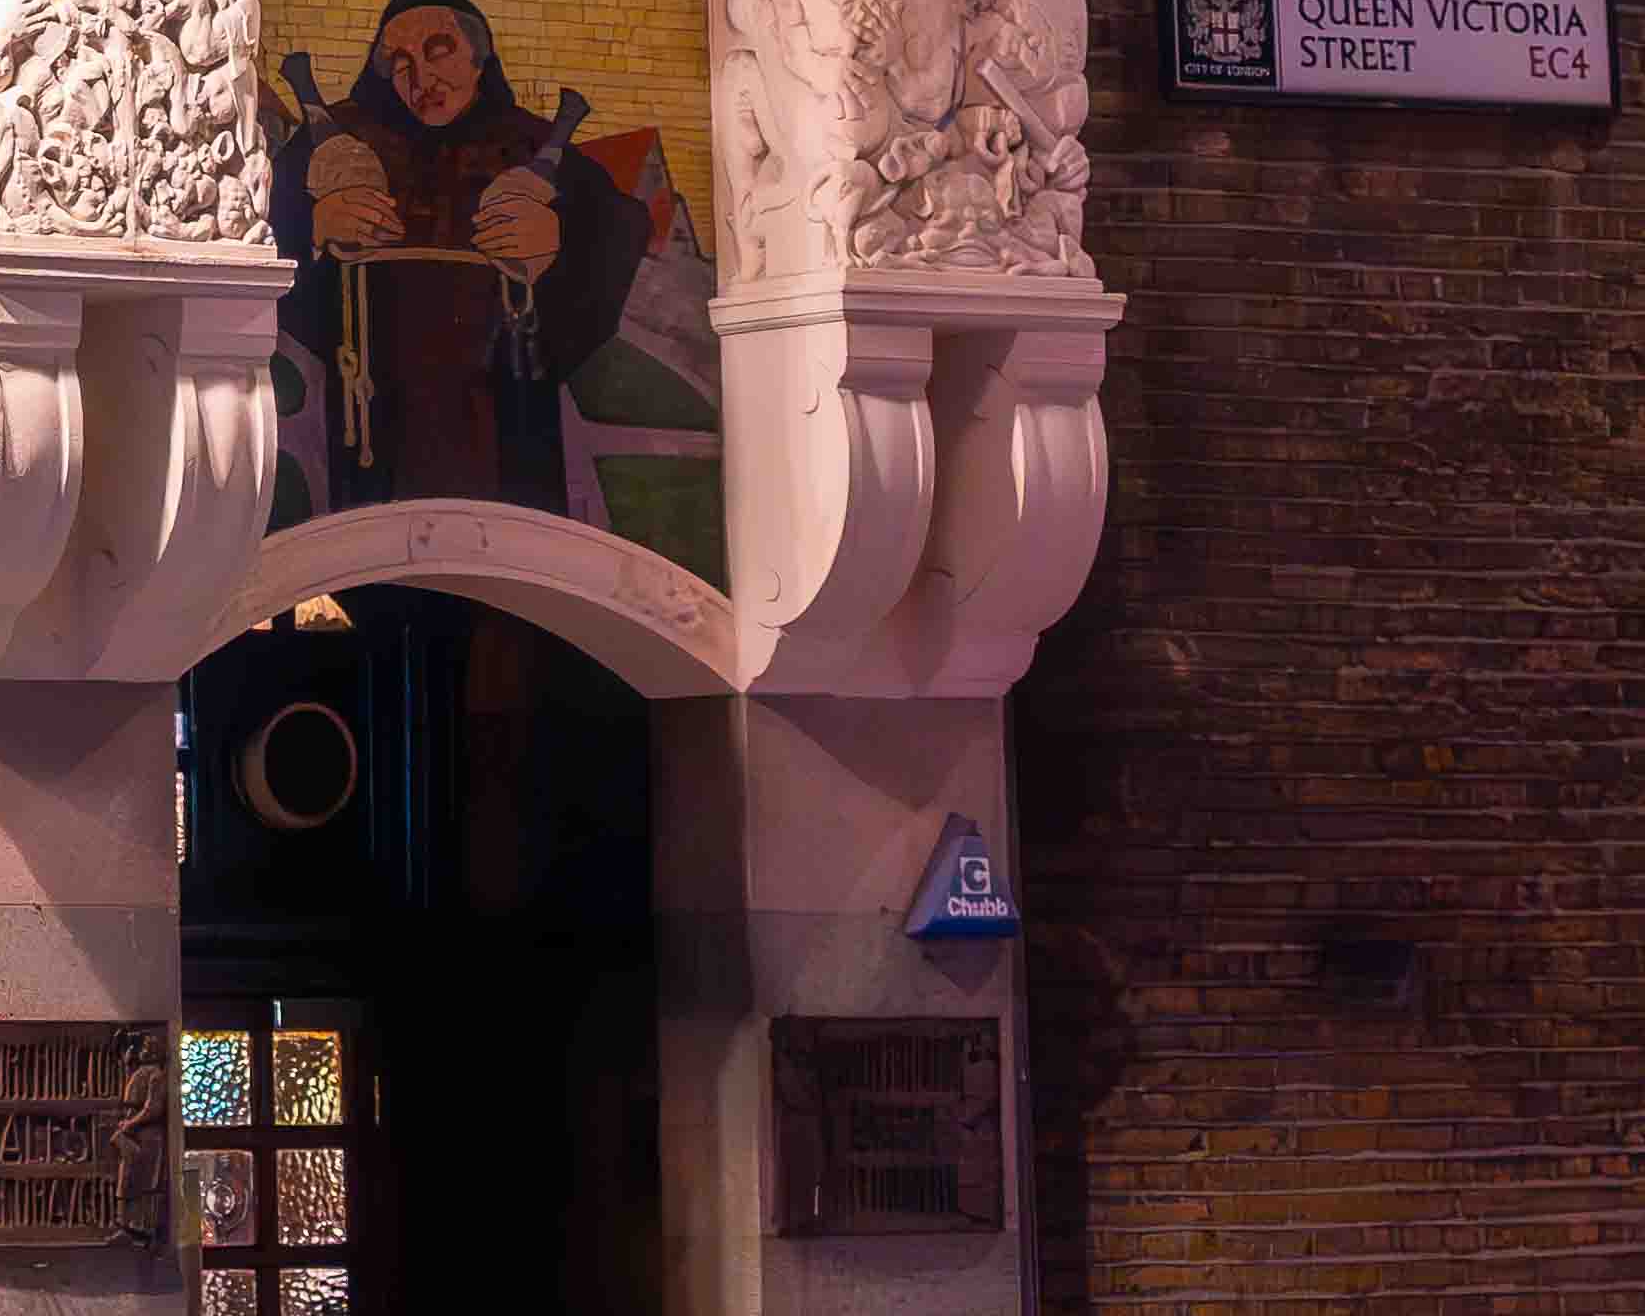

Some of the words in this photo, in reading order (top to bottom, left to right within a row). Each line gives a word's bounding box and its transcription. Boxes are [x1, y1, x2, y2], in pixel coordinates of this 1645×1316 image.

[1300, 35, 1417, 72] STREET
[1528, 45, 1590, 80] EC4
[948, 896, 1009, 917] Chubb
